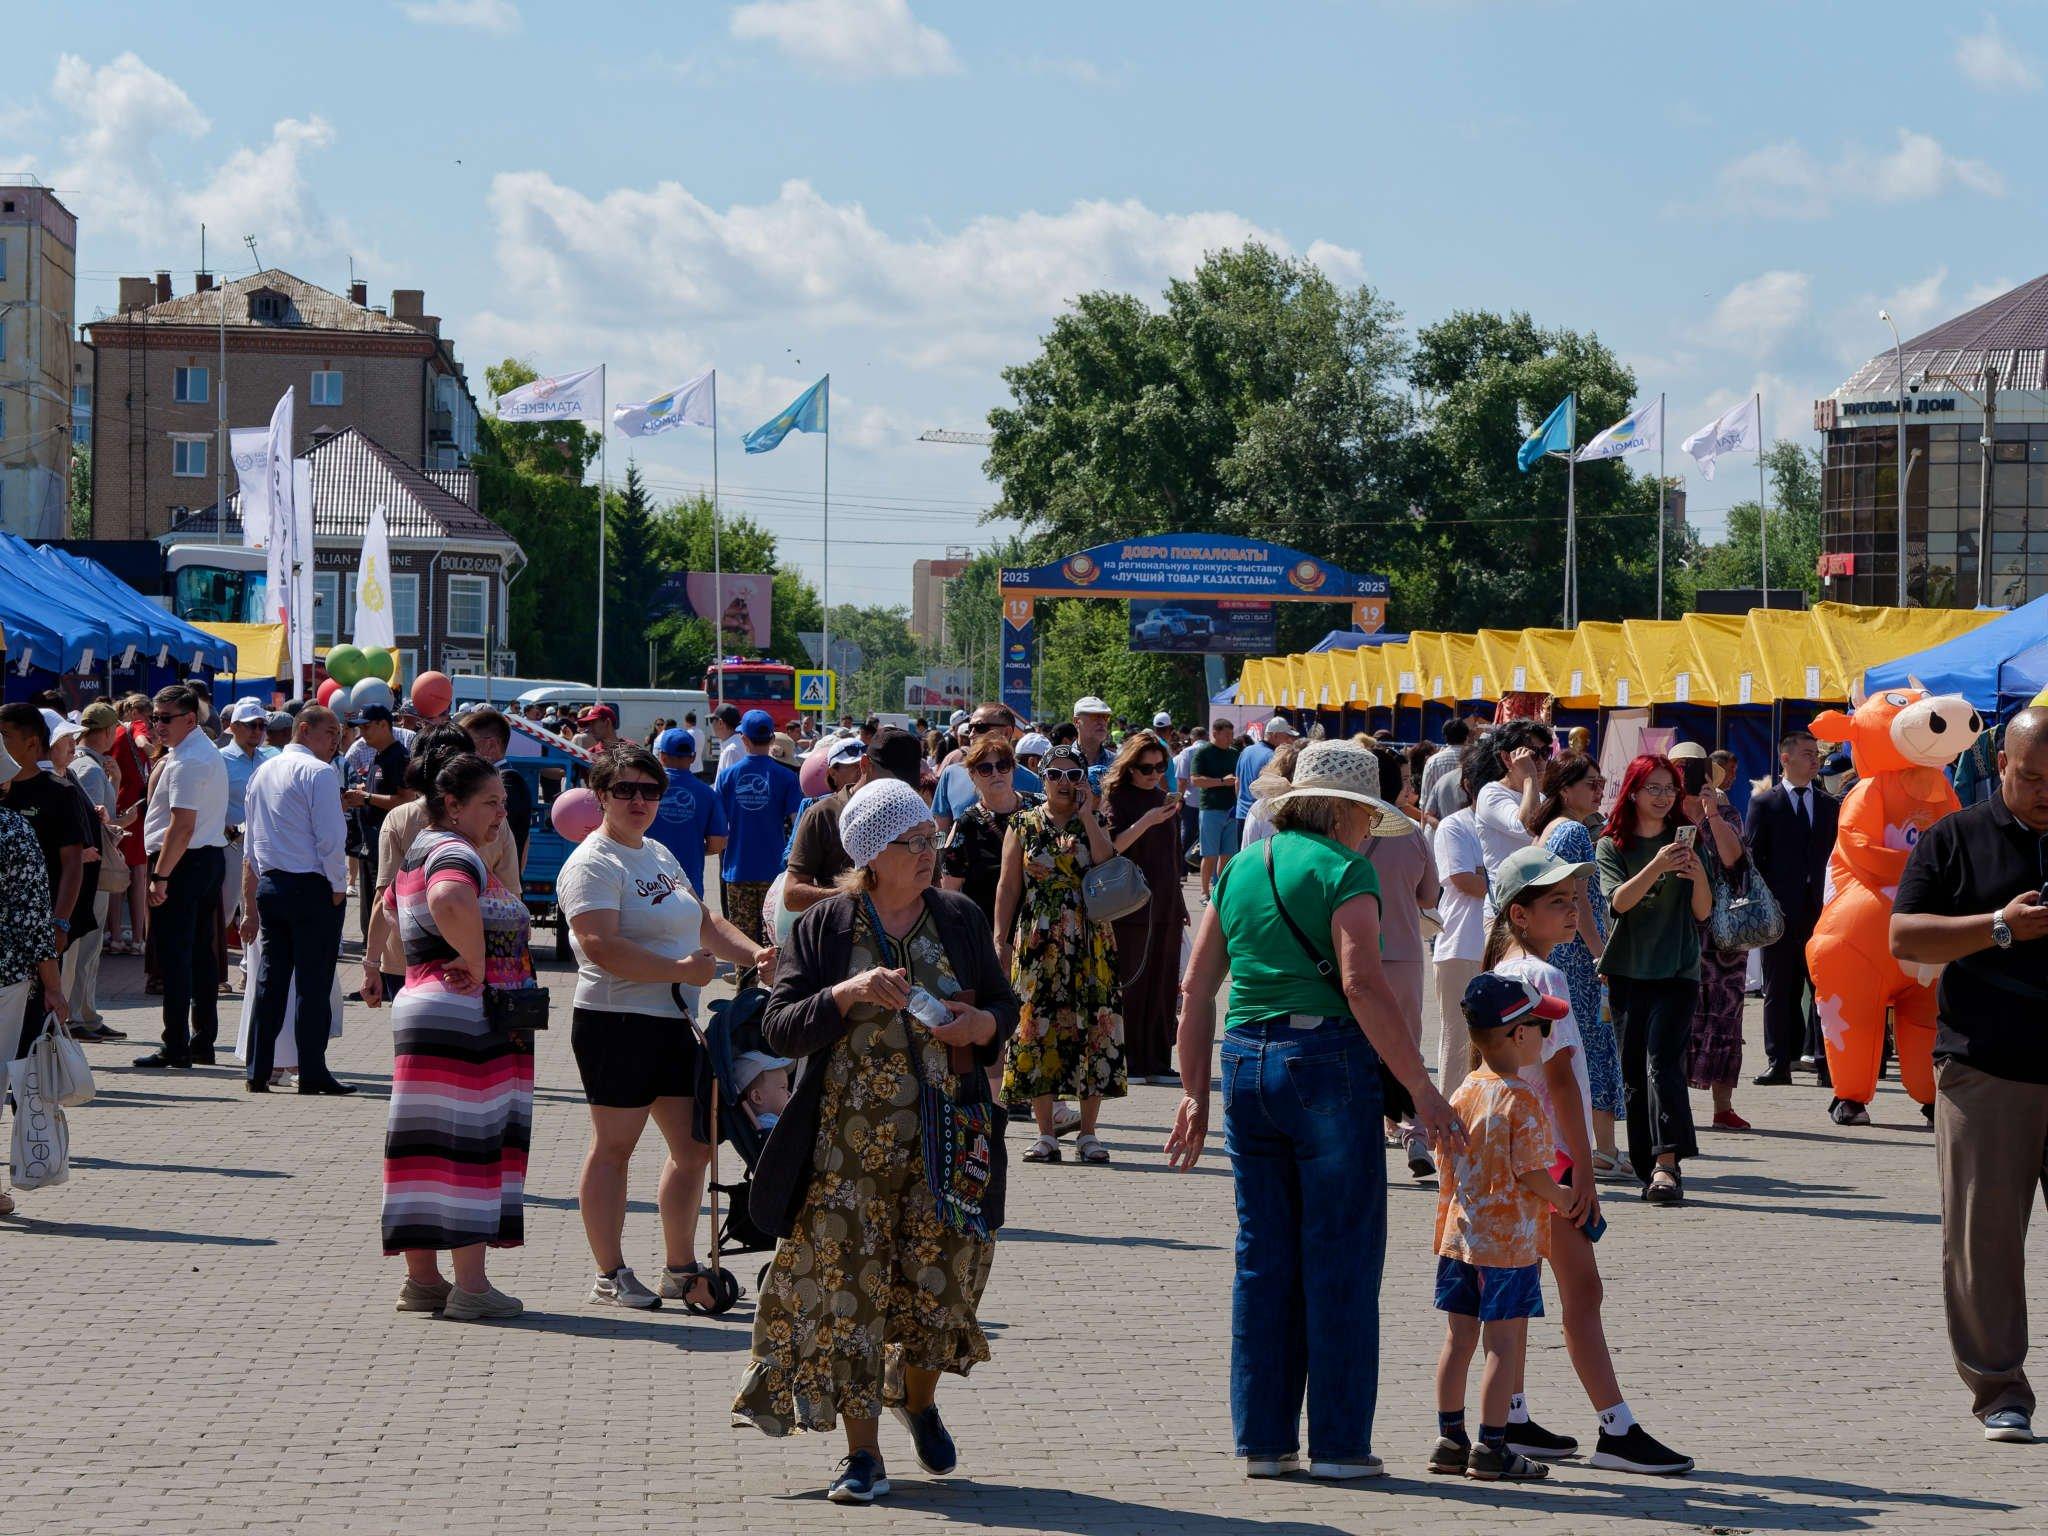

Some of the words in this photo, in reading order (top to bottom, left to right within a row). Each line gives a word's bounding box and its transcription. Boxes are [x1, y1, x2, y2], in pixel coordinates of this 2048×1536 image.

[1842, 397, 1912, 415] ТОРГОВЫЙ
[1917, 398, 1955, 414] ДОМ
[314, 554, 351, 565] ALIAN
[1121, 546, 1168, 560] ДОБРО
[1170, 547, 1268, 561] ПОЖАЛОВАТЬ!
[391, 555, 412, 567] INE
[1118, 561, 1190, 572] региональную
[1192, 563, 1285, 575] конкурс-выставку
[1002, 572, 1030, 583] 2025
[1111, 571, 1165, 583] «ЛУЧШИЙ
[1168, 573, 1200, 584] ТОВАР
[1203, 575, 1276, 585] КАЗАХСТАНА»
[1358, 581, 1386, 593] 2025
[1010, 600, 1028, 615] 19
[1361, 606, 1380, 620] 19
[24, 1072, 50, 1179] DeFacto
